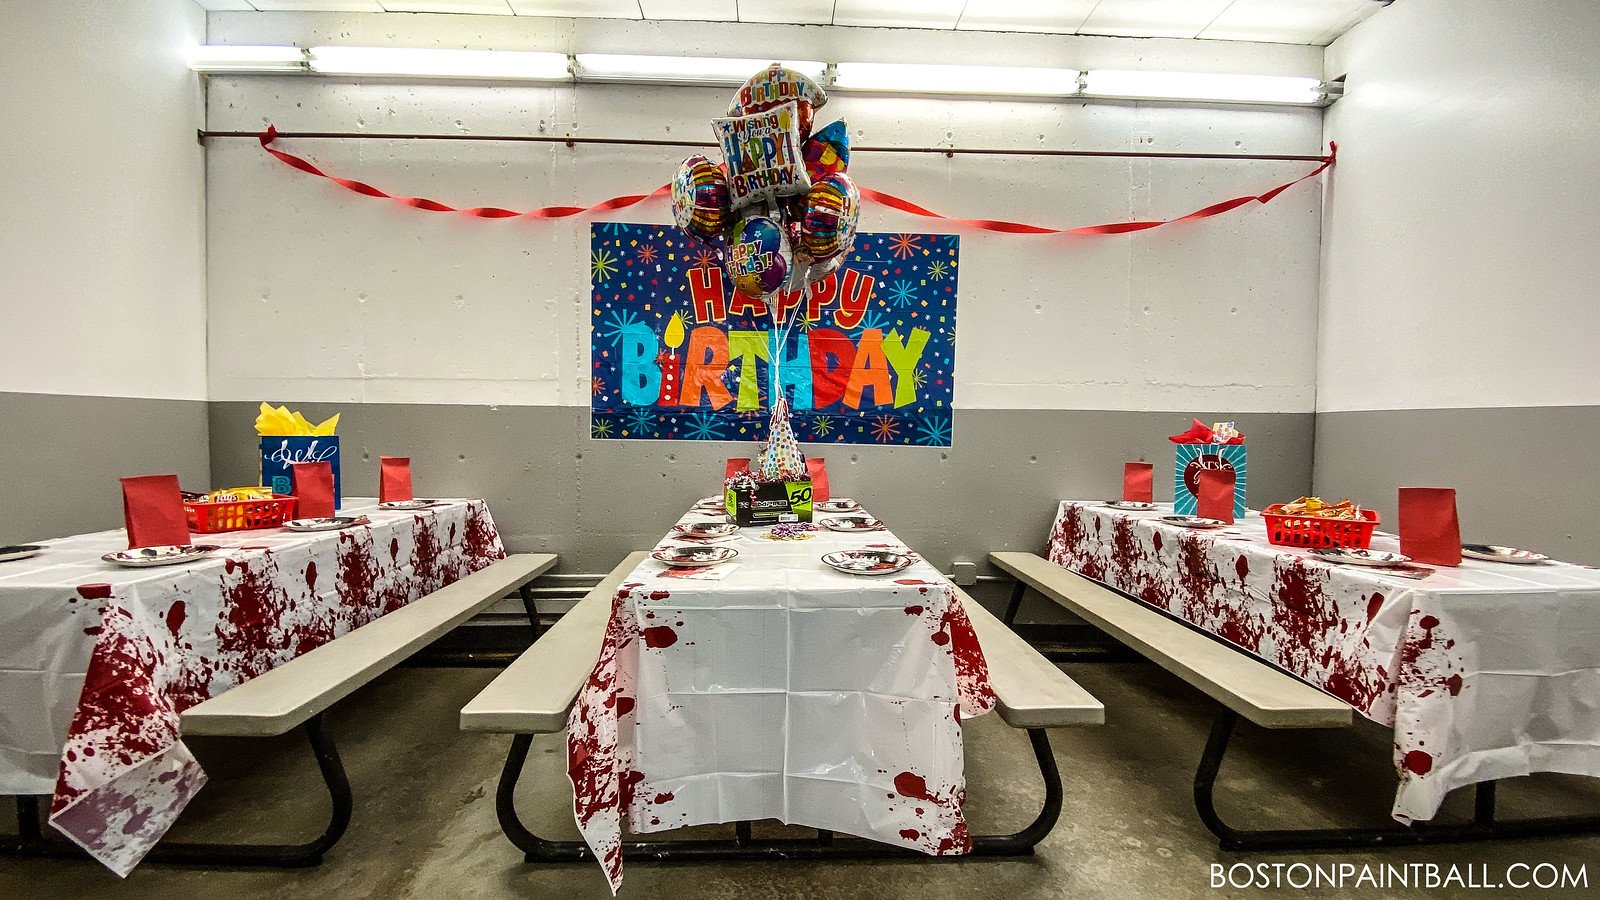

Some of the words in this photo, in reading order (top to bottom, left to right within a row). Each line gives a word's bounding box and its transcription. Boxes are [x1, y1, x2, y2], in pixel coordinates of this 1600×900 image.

[740, 81, 805, 108] BIRTHDAY
[733, 164, 795, 198] BIRTHDAY
[688, 266, 875, 330] HAPPY
[621, 318, 931, 412] BIRTHDAY
[789, 487, 812, 506] 50
